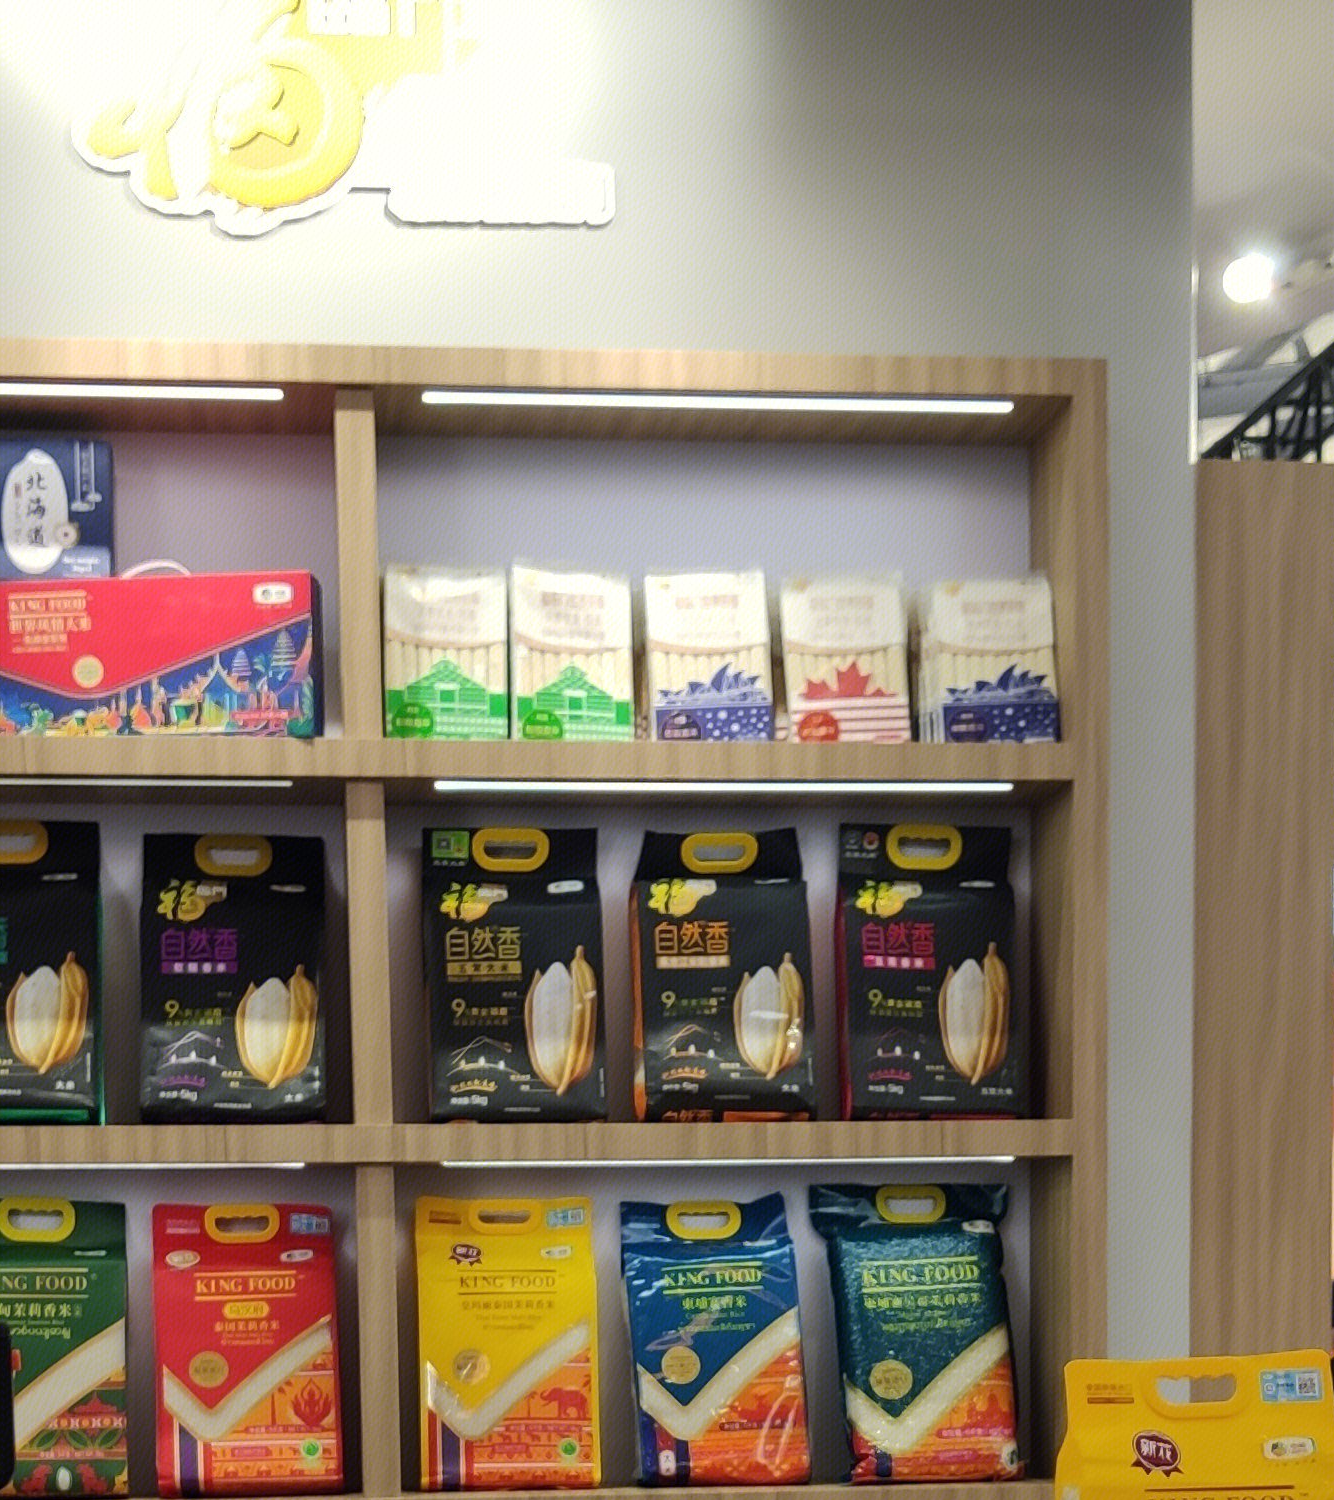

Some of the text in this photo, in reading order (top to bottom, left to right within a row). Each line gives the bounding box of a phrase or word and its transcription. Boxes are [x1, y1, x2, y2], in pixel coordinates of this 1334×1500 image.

[161, 929, 238, 961] 自然香
[445, 925, 523, 960] 自然香
[655, 920, 730, 954] 自然香
[861, 922, 935, 956] 自然香
[34, 1275, 89, 1291] FOOD
[195, 1276, 296, 1294] KING FOOD
[459, 1274, 556, 1289] KING FOOD
[664, 1268, 763, 1287] KING FOOD
[862, 1264, 979, 1286] KING FOOD
